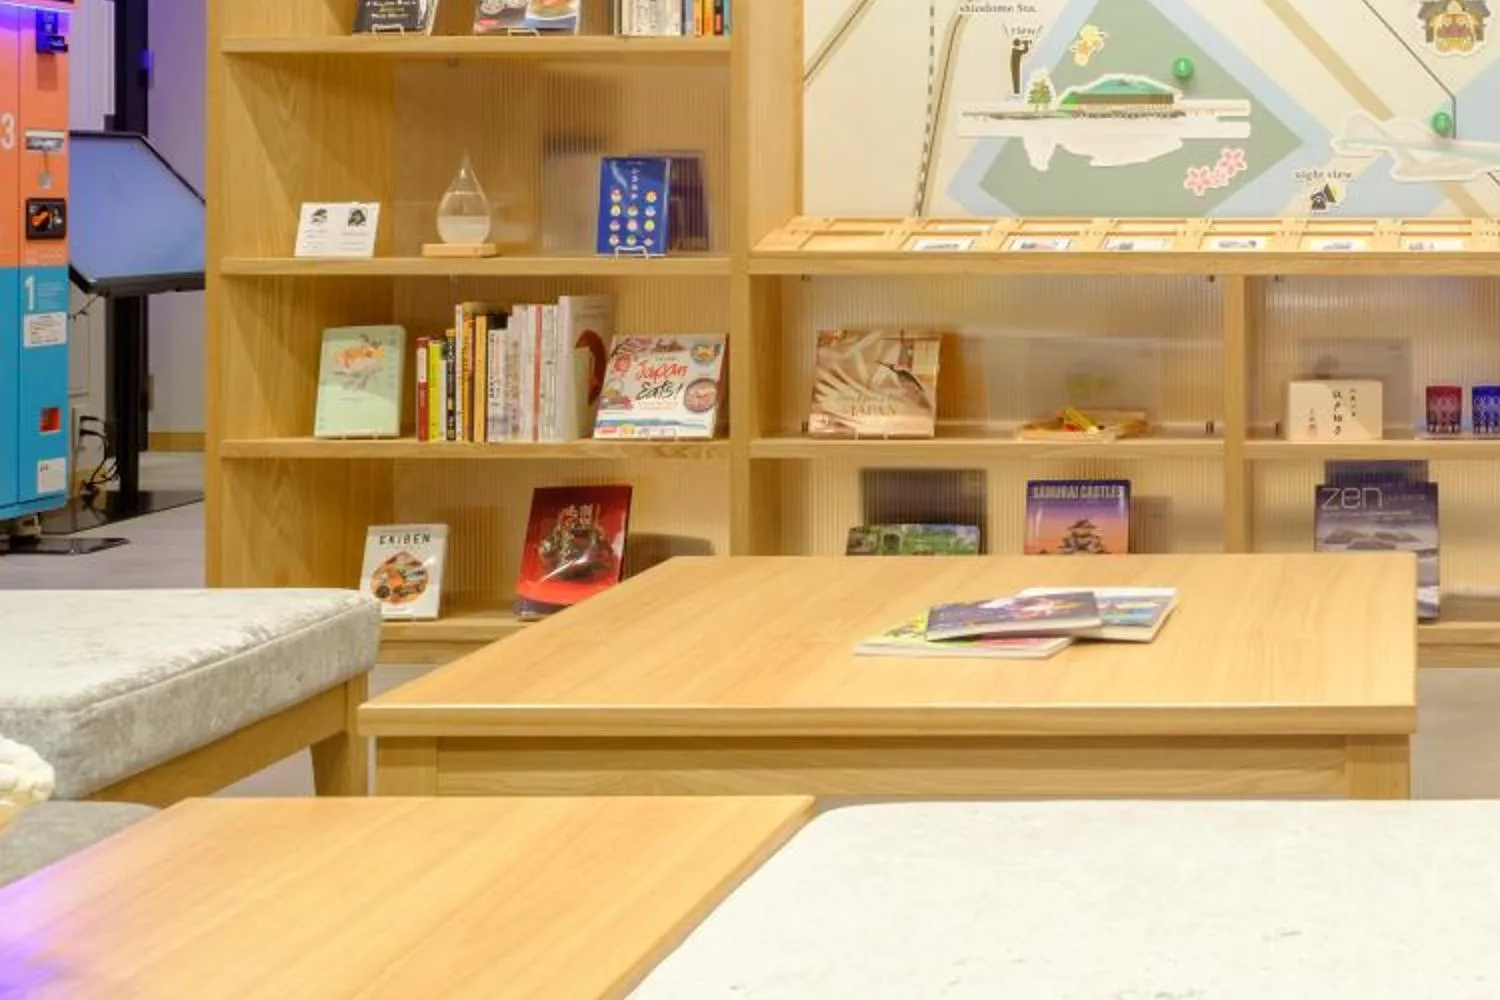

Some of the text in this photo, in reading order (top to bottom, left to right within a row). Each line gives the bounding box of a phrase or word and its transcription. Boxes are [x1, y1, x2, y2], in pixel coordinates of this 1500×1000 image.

[0, 112, 15, 150] 3
[24, 275, 36, 311] 1
[1321, 487, 1383, 510] zen
[379, 532, 431, 546] EKIBEN
